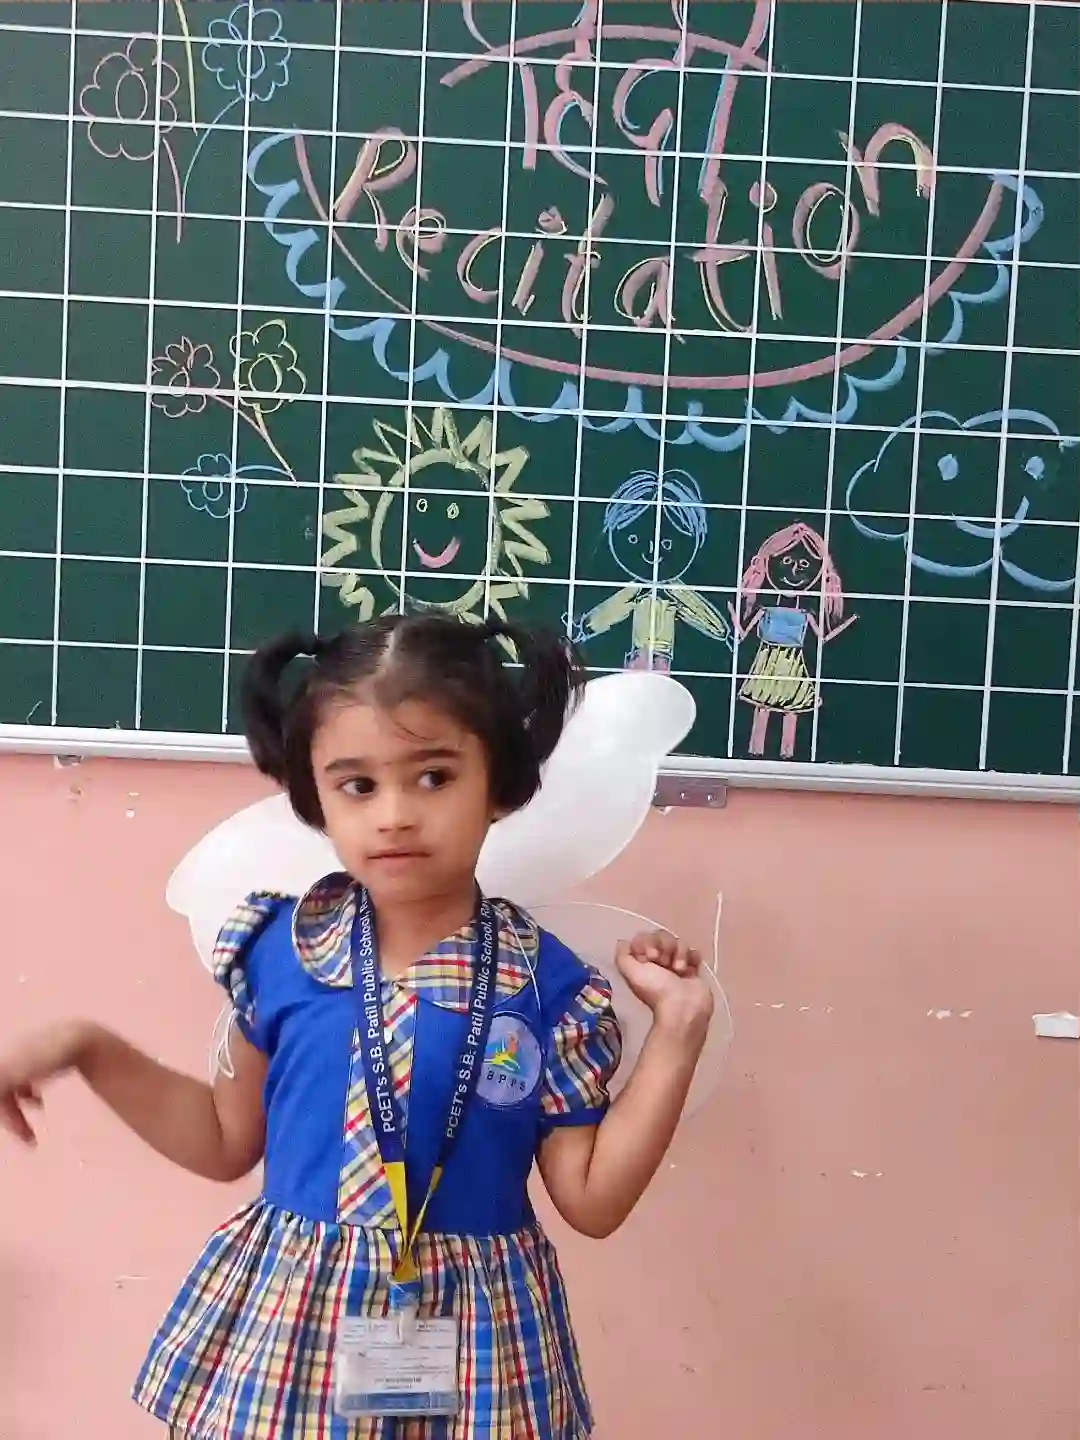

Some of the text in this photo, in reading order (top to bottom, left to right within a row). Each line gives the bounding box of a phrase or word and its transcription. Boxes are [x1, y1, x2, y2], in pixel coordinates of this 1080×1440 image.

[333, 122, 934, 342] Recitation
[362, 959, 377, 1002] Public
[474, 967, 490, 1009] Public
[365, 1005, 380, 1038] Patil
[467, 1012, 484, 1045] Patil
[370, 1041, 384, 1073] S.B.
[376, 1076, 395, 1133] PCET's
[446, 1083, 467, 1138] PCET's
